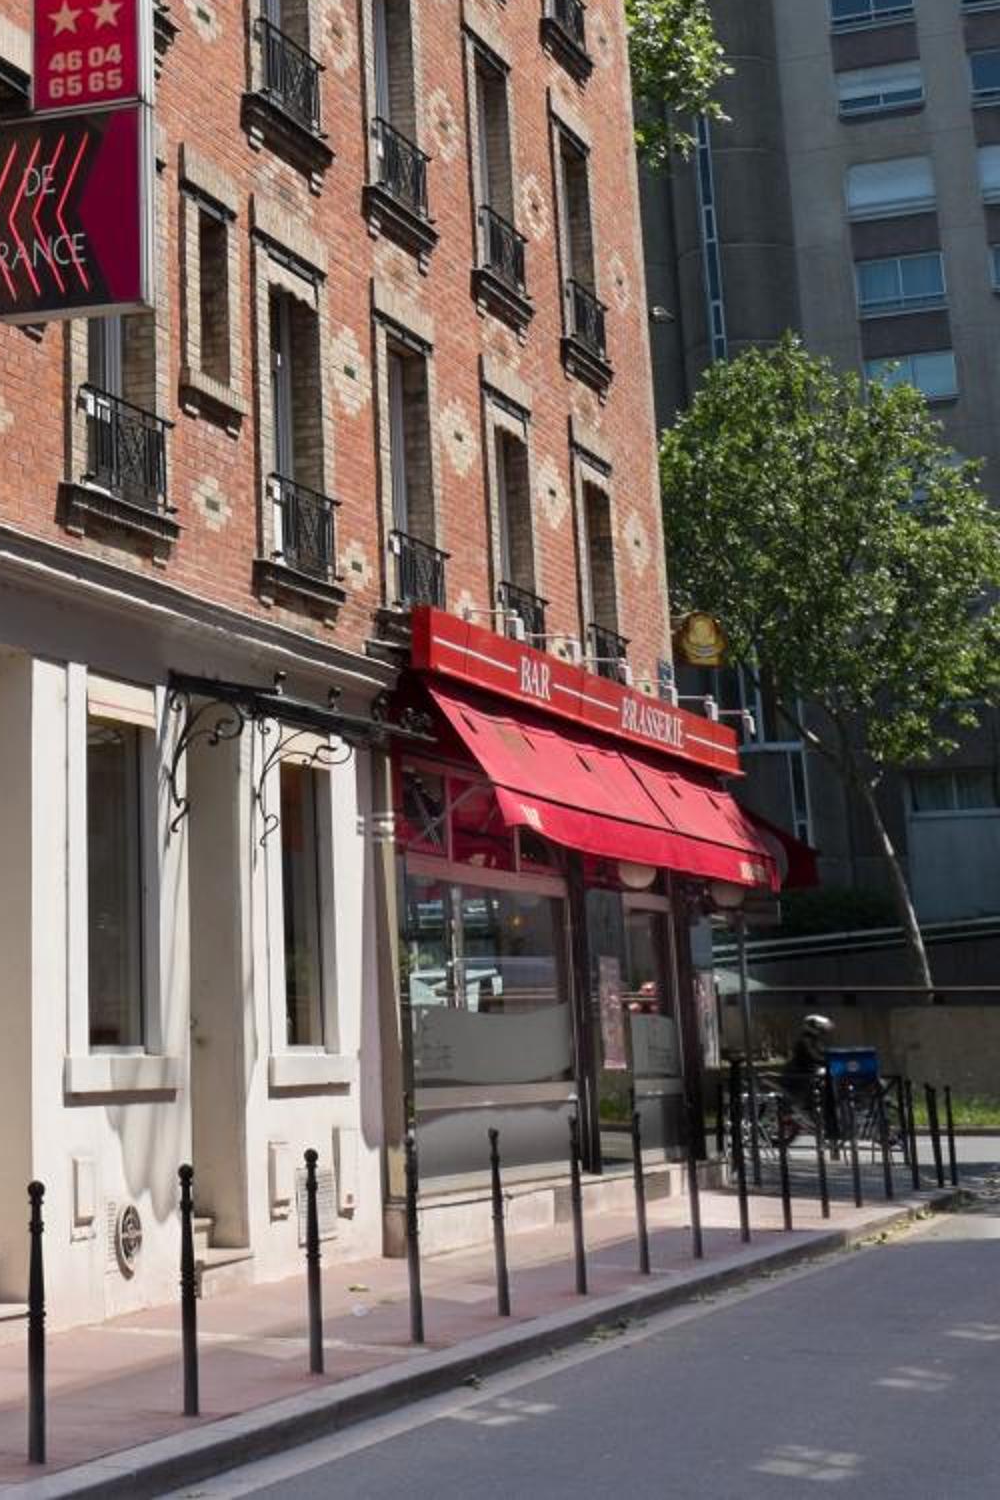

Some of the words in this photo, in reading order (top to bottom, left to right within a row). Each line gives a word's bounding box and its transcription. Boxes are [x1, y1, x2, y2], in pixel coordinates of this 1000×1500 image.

[48, 50, 83, 73] 46
[87, 43, 123, 68] 04
[48, 75, 83, 99] 65
[87, 69, 123, 93] 65
[23, 164, 56, 197] DE
[519, 655, 551, 701] BAR
[621, 696, 685, 749] BRASSERIE
